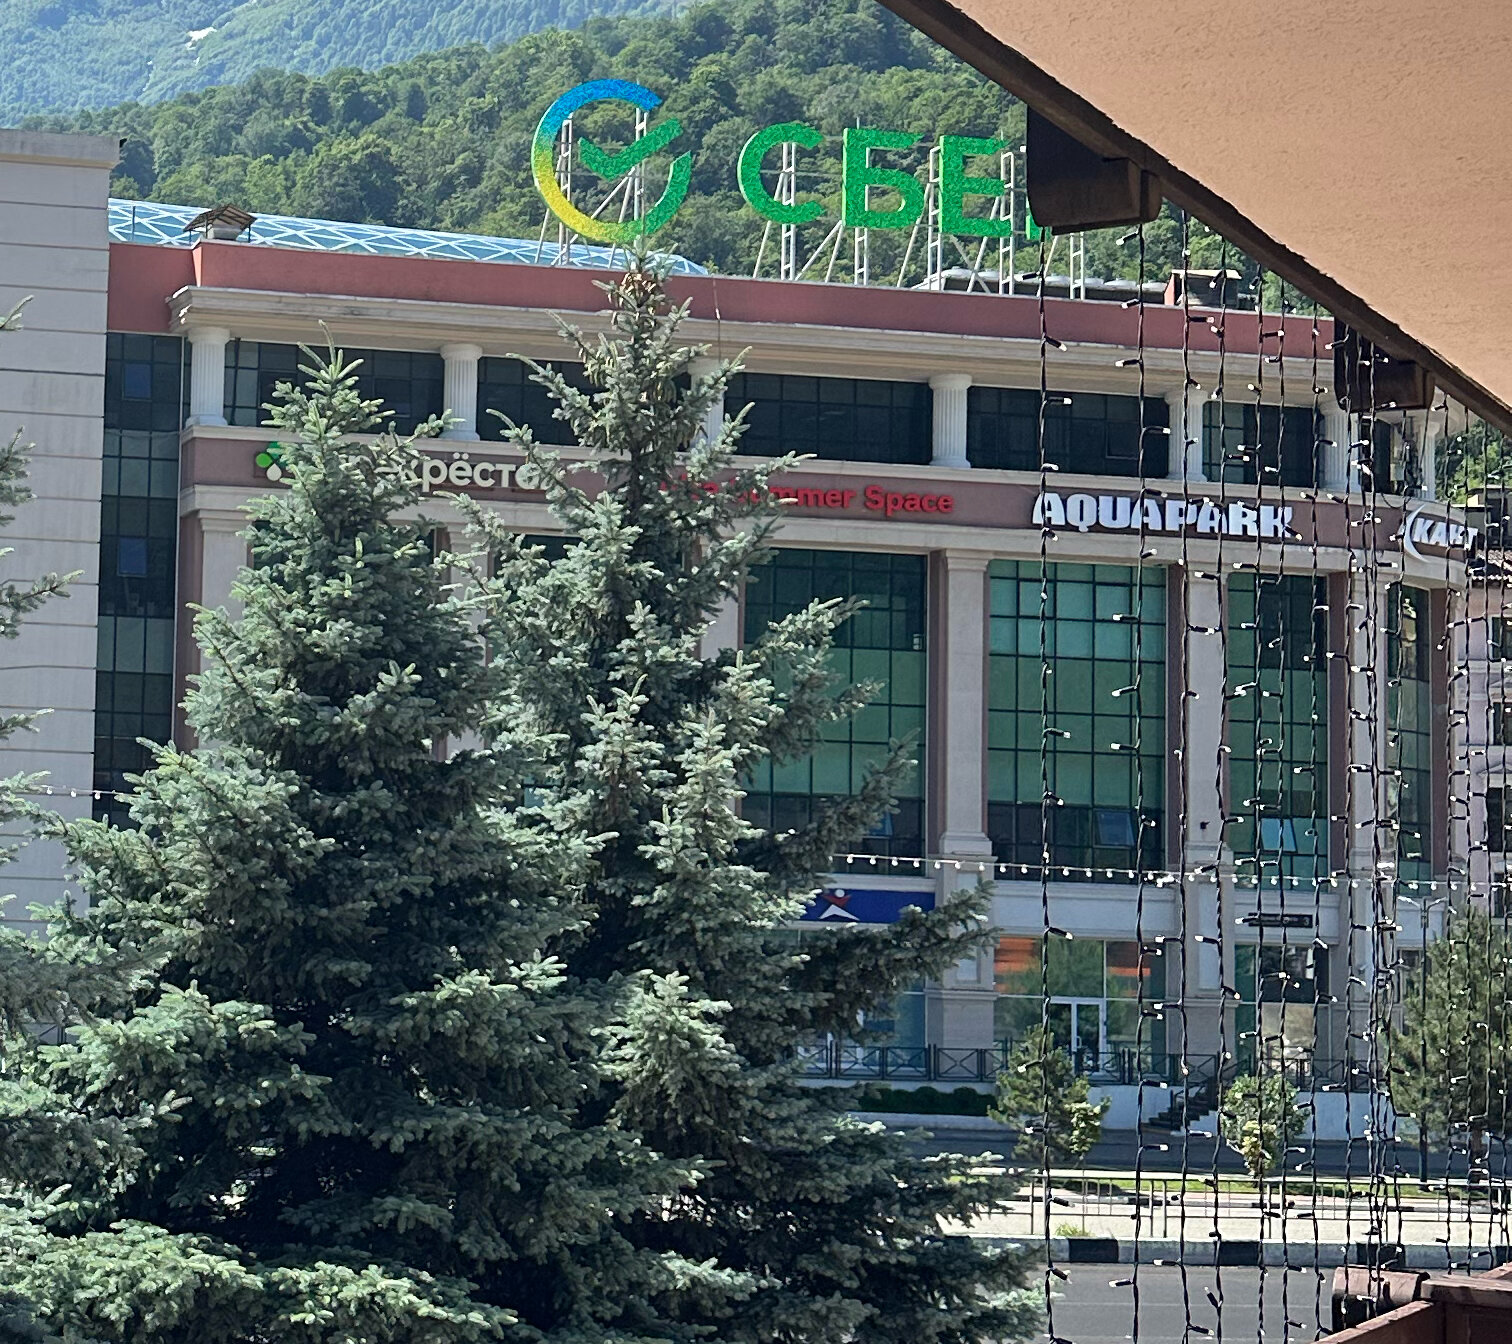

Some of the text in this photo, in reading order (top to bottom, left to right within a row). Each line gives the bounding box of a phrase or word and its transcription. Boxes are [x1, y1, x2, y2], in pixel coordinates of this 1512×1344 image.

[737, 121, 1048, 240] СБЕ
[865, 484, 955, 516] Space
[1032, 492, 1293, 538] AQUAPARK
